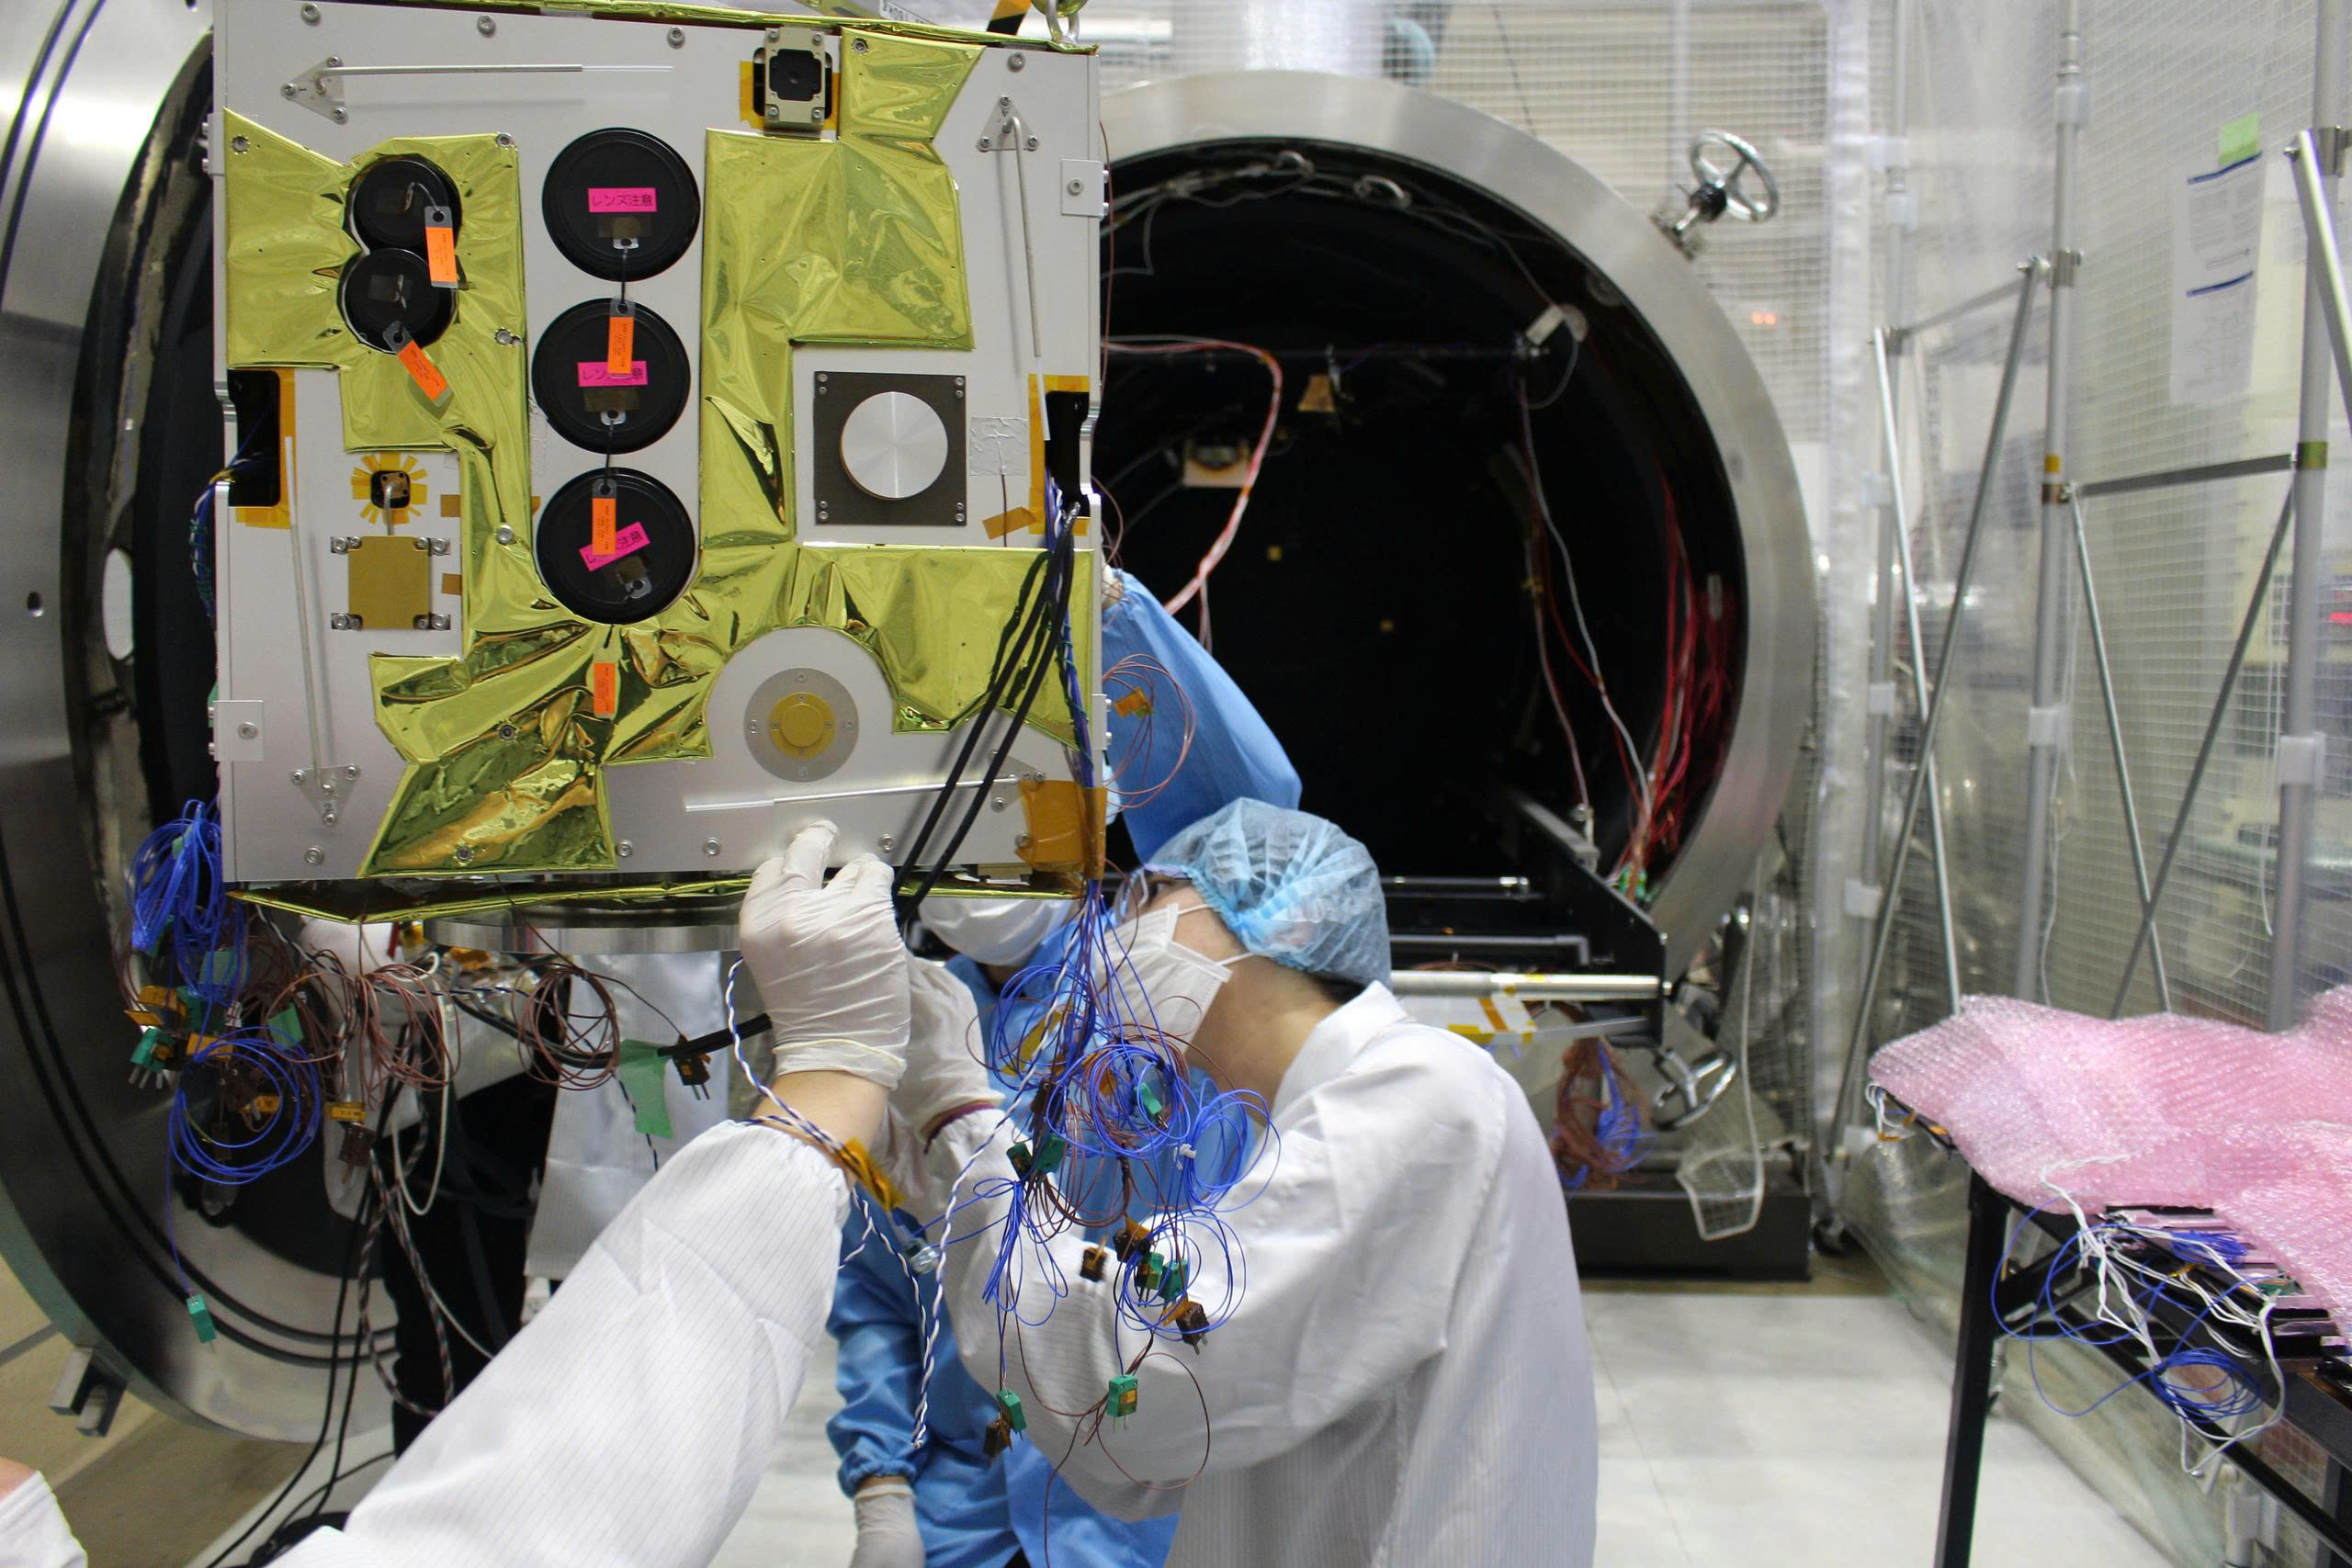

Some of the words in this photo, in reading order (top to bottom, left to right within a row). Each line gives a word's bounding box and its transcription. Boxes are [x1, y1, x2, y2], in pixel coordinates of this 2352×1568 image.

[592, 194, 654, 207] レンズ注意
[582, 367, 642, 380] レン意
[585, 531, 642, 564] レ注意
[323, 803, 334, 812] 2
